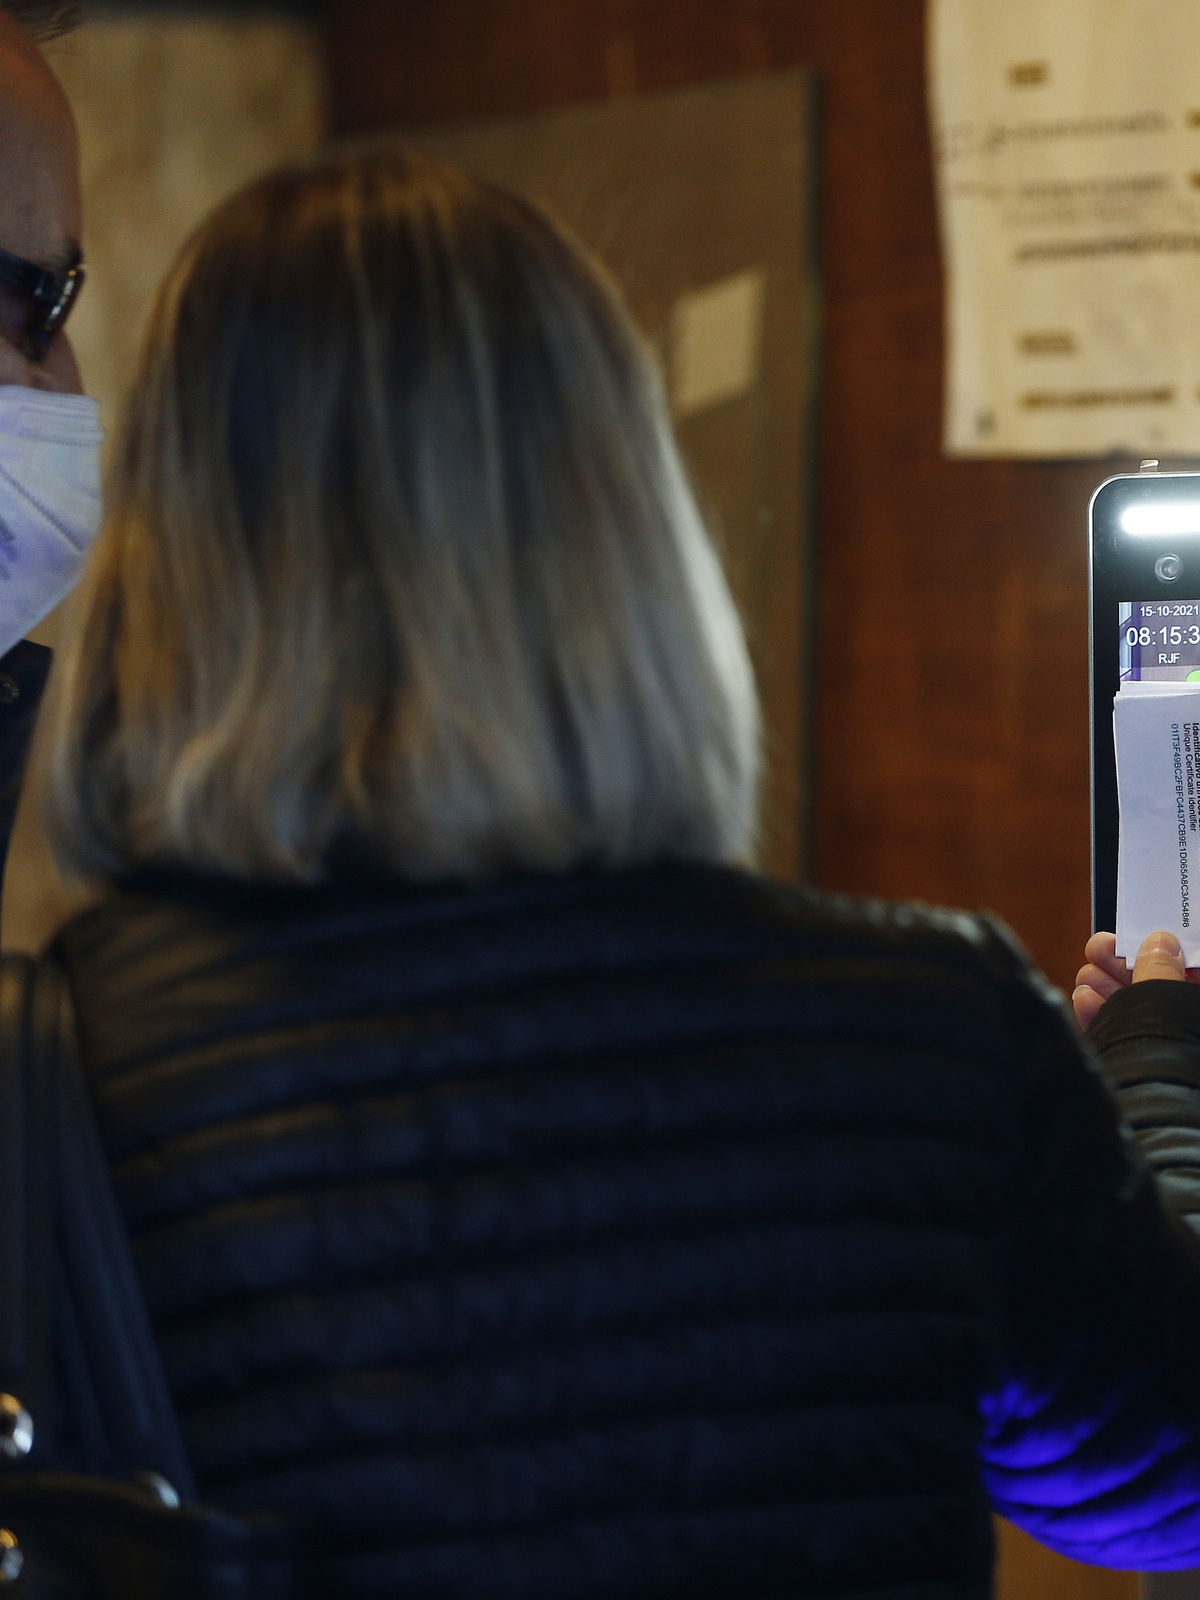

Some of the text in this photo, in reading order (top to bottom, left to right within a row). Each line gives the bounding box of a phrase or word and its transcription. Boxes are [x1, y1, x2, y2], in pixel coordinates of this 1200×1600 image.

[1139, 604, 1200, 618] 15-10-2021
[1158, 652, 1181, 665] RJF
[1182, 723, 1198, 832] Unique Certificate identifier
